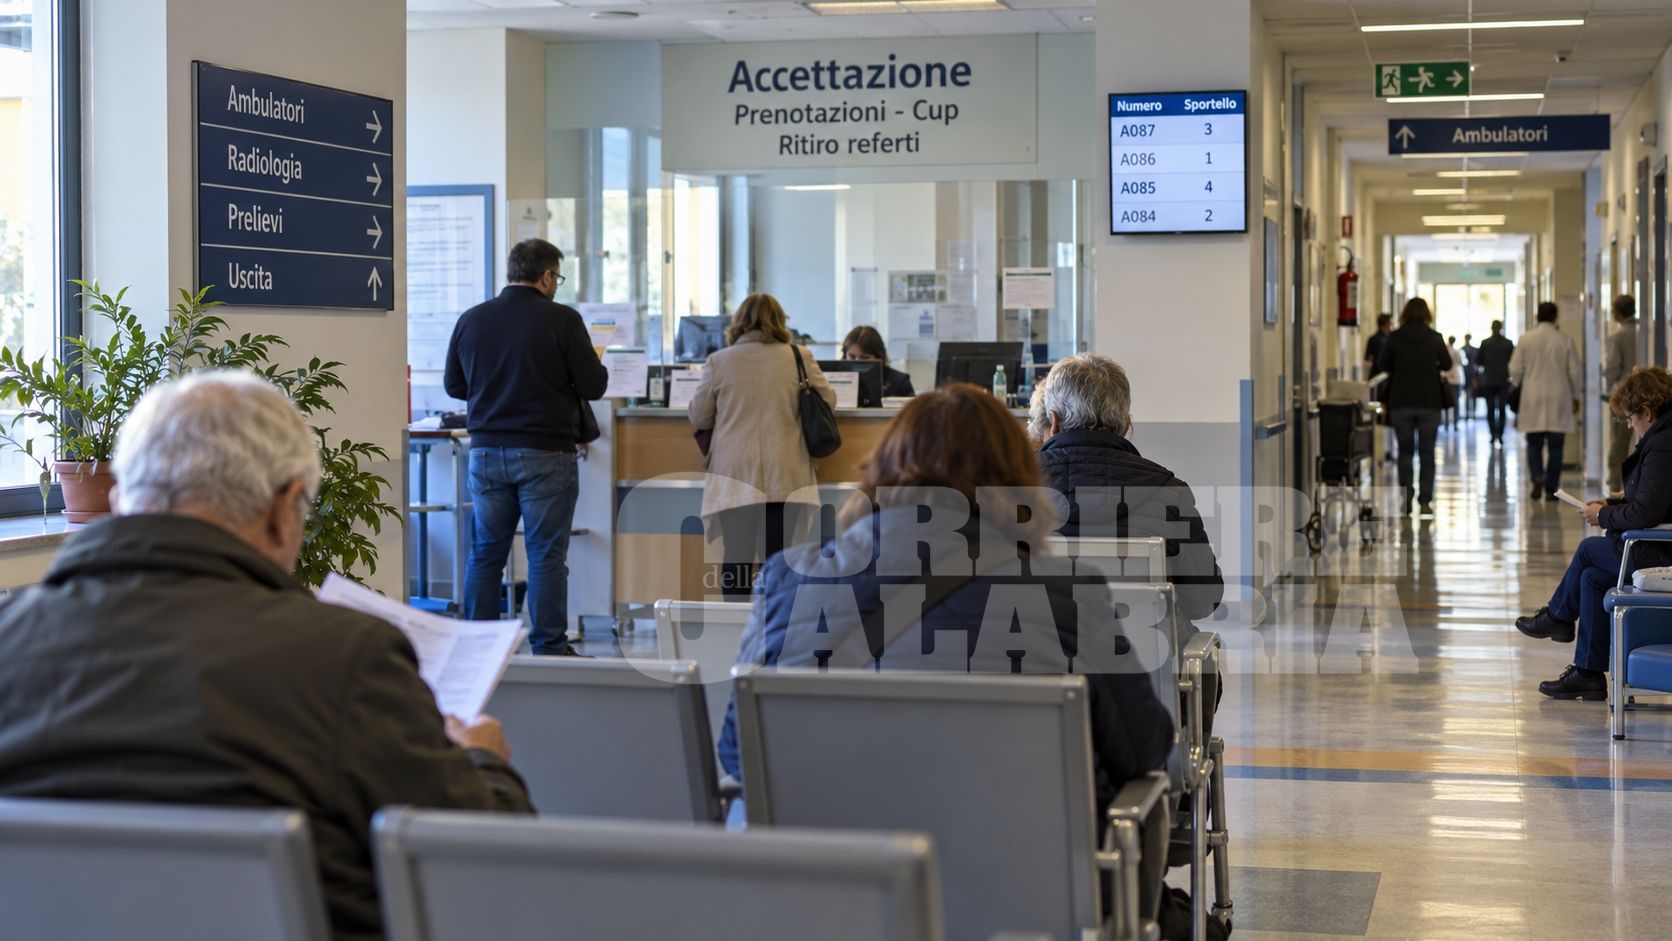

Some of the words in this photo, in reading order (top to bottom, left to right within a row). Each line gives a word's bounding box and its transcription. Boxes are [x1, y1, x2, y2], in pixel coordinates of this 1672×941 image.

[728, 54, 972, 93] Accettazione
[227, 84, 305, 124] Ambulatori
[735, 101, 886, 125] Prenotazioni
[913, 99, 959, 125] Cup
[1117, 100, 1163, 112] Numero
[1184, 97, 1237, 112] Sportello
[1120, 124, 1156, 138] A087
[1204, 122, 1213, 135] 3
[1452, 125, 1549, 144] Ambulatori
[779, 133, 839, 155] Ritiro
[848, 131, 920, 153] referti
[228, 144, 302, 184] Radiologia
[1120, 152, 1156, 166] A086
[1205, 151, 1213, 165] 1
[1120, 181, 1156, 194] A085
[1204, 180, 1213, 193] 4
[228, 203, 283, 233] Prelievi
[1121, 210, 1157, 223] A084
[1204, 209, 1213, 222] 2
[228, 262, 273, 290] Uscita
